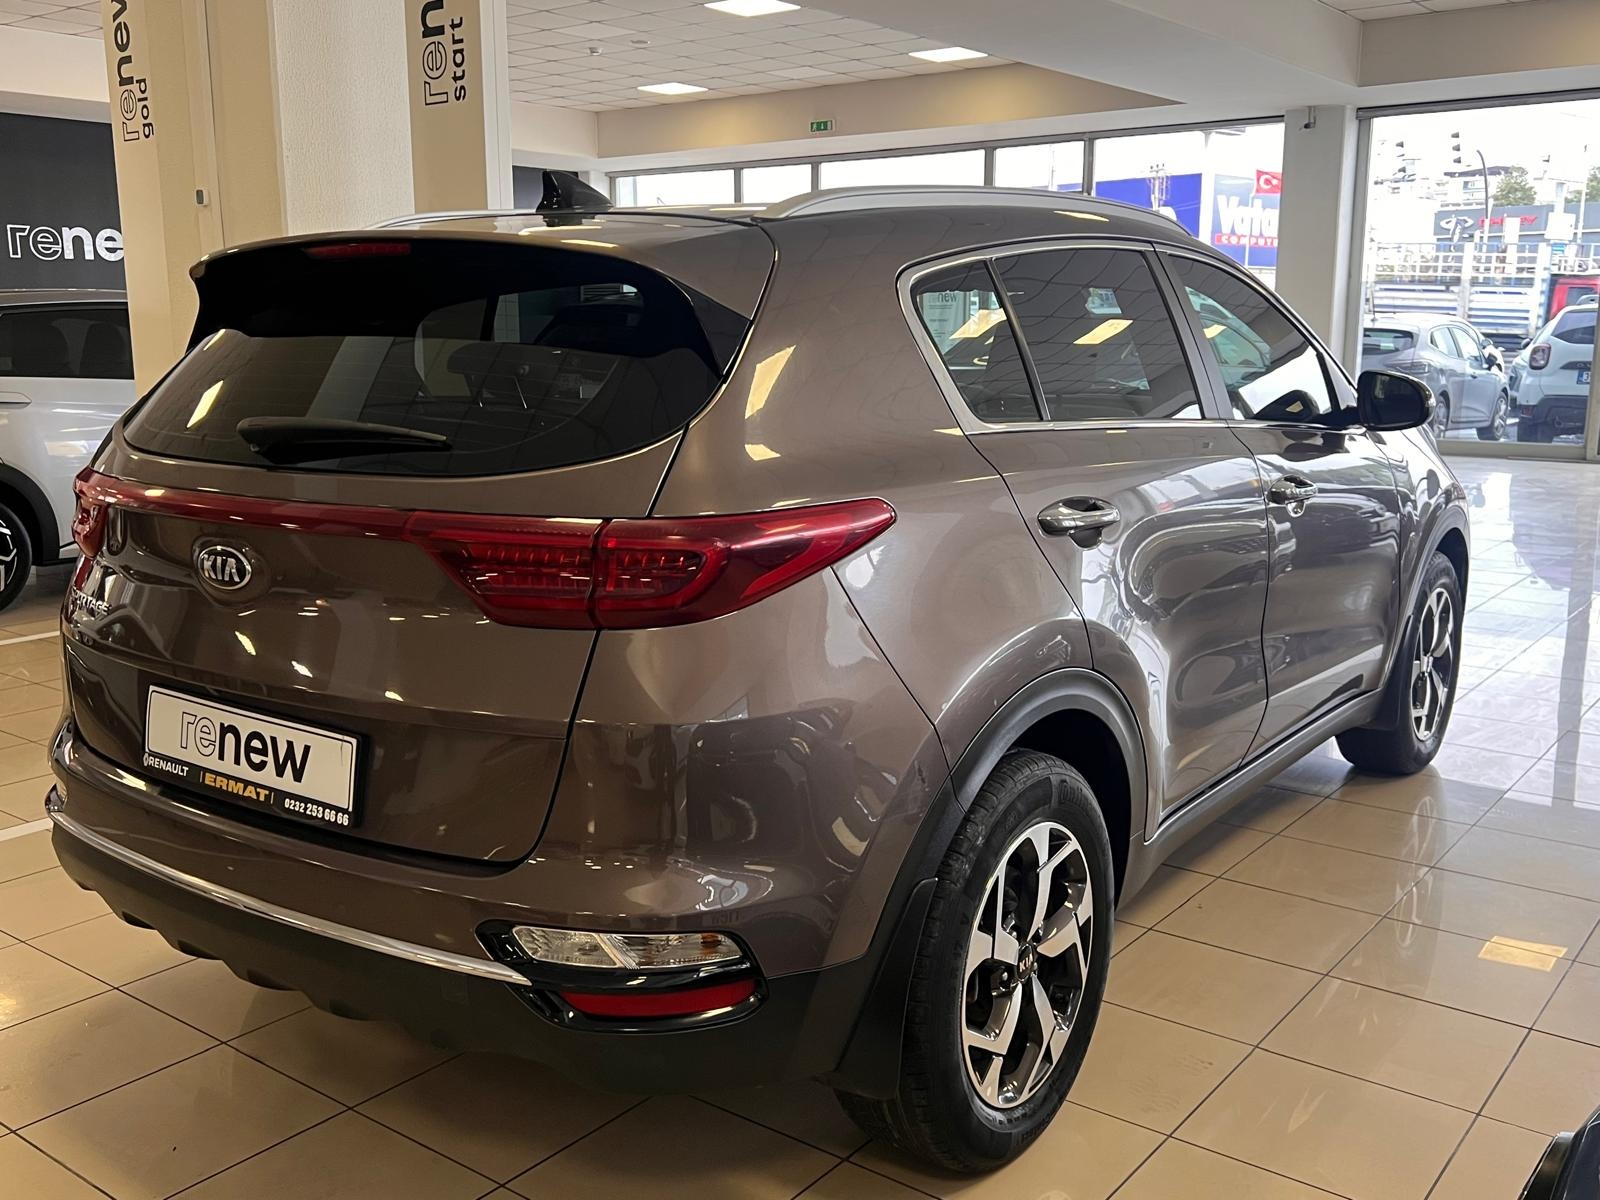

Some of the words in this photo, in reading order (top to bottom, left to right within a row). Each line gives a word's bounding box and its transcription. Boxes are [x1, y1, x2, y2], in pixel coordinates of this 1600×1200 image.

[421, 0, 448, 105] ren
[449, 17, 466, 101] start
[135, 78, 154, 138] gold
[1216, 194, 1280, 237] Vata
[6, 224, 124, 262] rene
[202, 554, 240, 582] KIA
[148, 756, 189, 777] RENAULT
[180, 711, 312, 784] renew
[204, 771, 269, 802] ERMAT
[284, 798, 306, 813] 0232
[305, 803, 324, 818] 253
[323, 808, 337, 822] 66
[336, 812, 350, 826] 66
